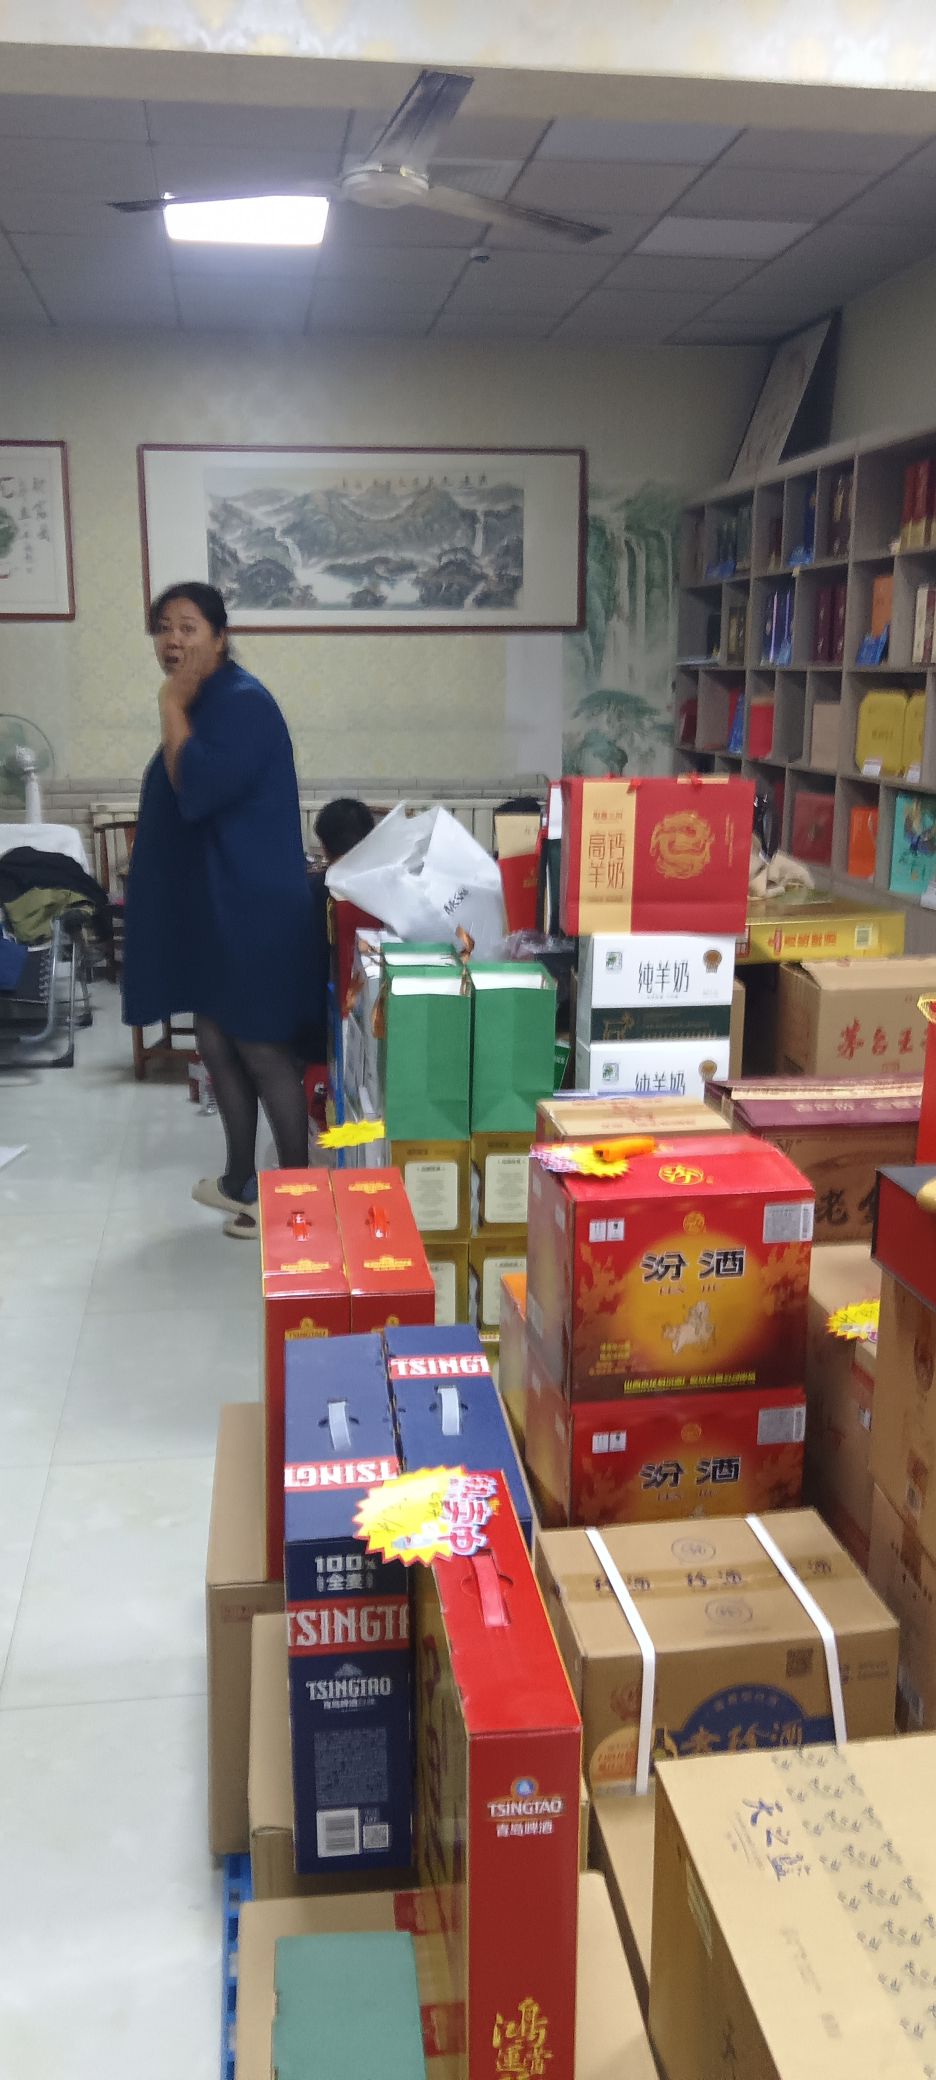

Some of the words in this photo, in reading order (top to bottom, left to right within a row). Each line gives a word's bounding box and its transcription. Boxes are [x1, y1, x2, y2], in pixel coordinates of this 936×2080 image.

[589, 830, 625, 860] 高钙
[589, 862, 625, 889] 羊奶
[638, 960, 690, 993] 纯羊奶
[838, 1017, 926, 1060] 茅台王
[640, 1247, 746, 1283] 汾酒
[639, 1457, 742, 1490] 汾酒
[306, 1677, 393, 1701] TSINGTAO
[488, 1797, 563, 1817] TSINGTAO
